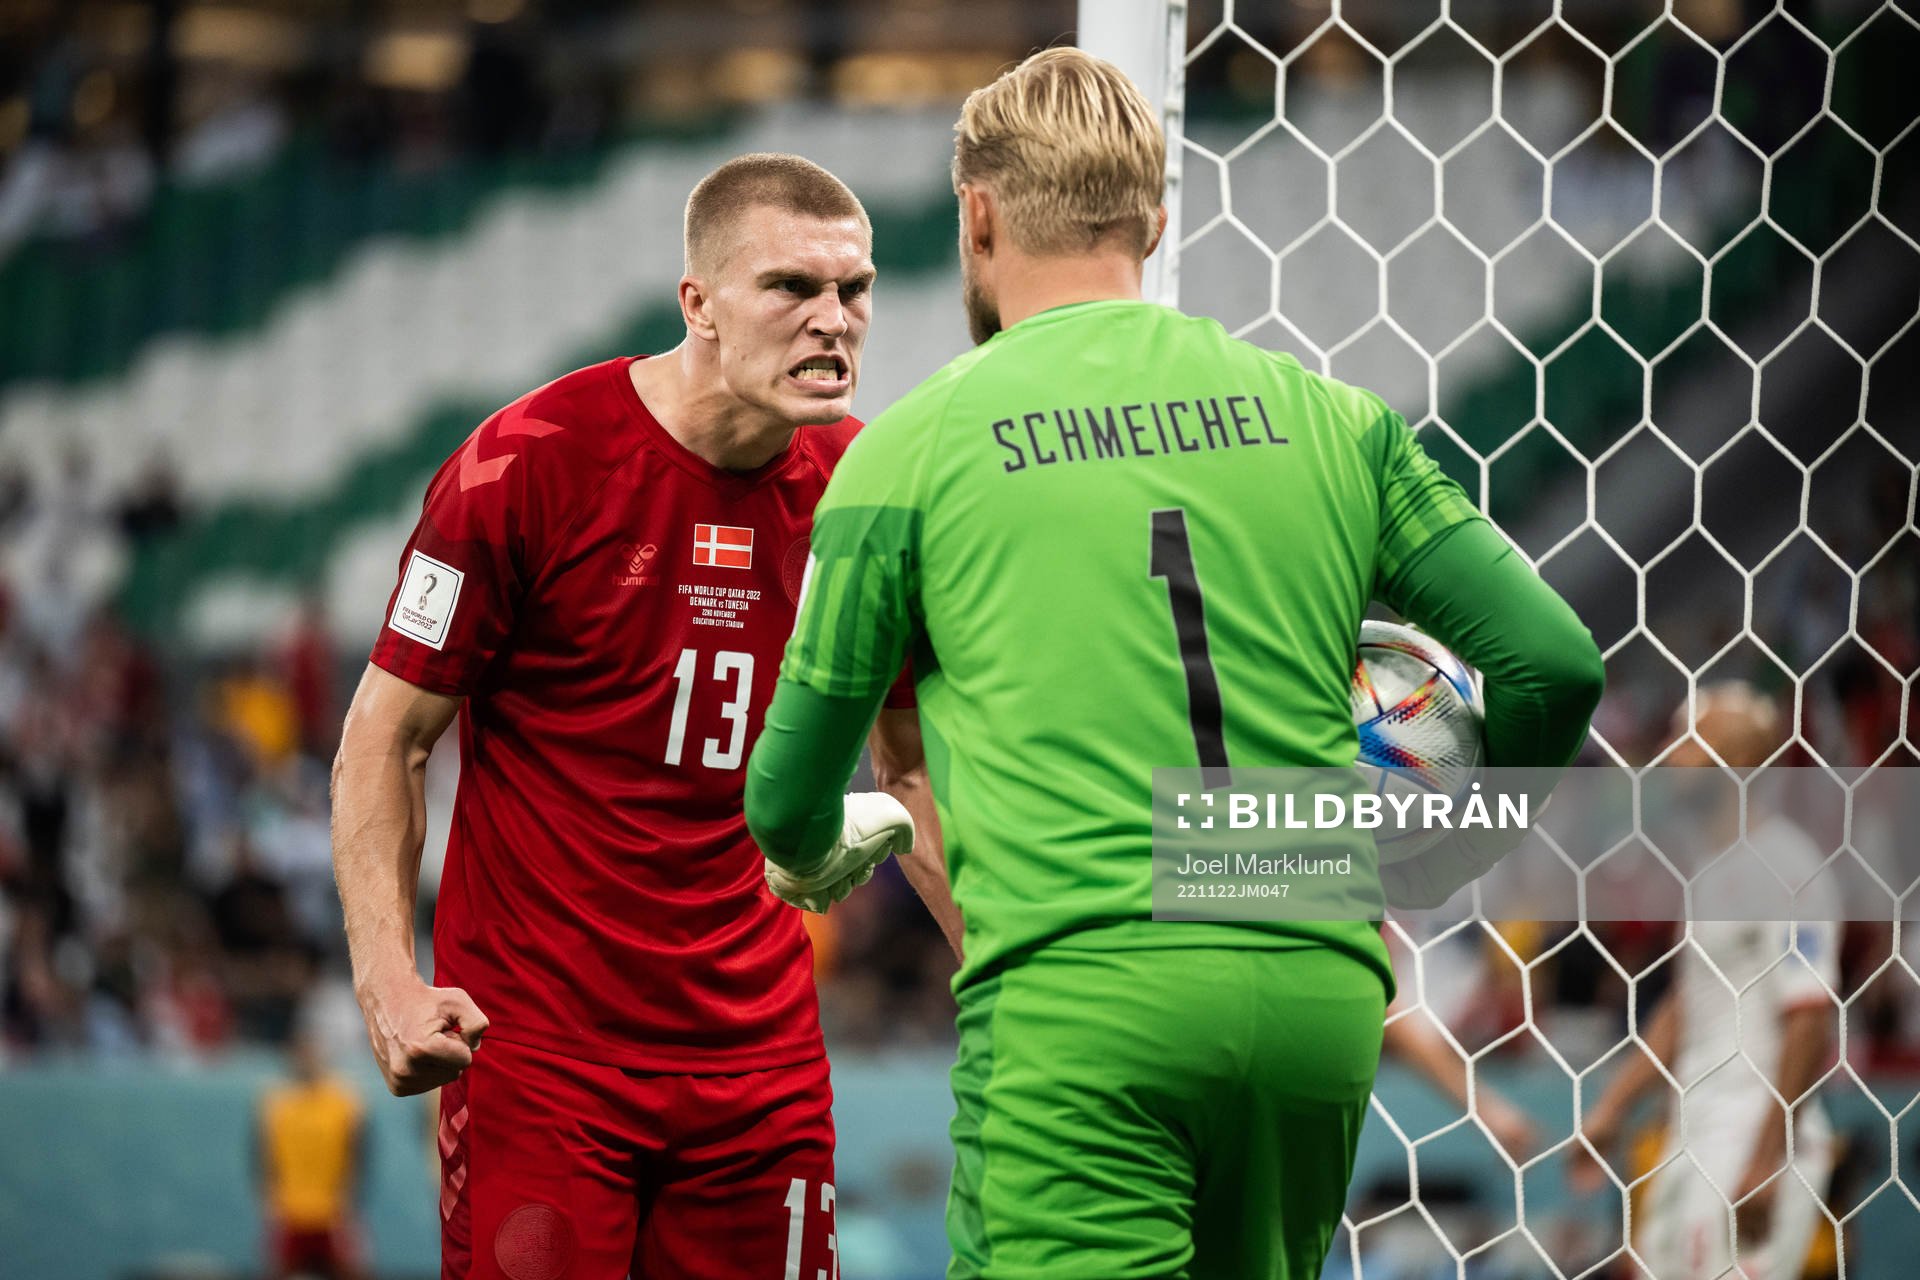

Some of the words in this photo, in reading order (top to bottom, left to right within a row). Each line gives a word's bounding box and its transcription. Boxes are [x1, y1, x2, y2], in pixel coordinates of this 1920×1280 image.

[992, 396, 1288, 473] SCHMEICHEL
[678, 584, 692, 594] FIFA
[694, 585, 714, 596] WORLD
[715, 587, 727, 597] CUP
[728, 588, 745, 599] QATAR
[746, 590, 761, 600] 2022
[690, 597, 717, 607] DENMARK
[410, 610, 426, 621] WORLD
[713, 610, 736, 619] NOVEMBER
[692, 616, 715, 626] EDUCATION
[715, 619, 725, 627] CITY
[725, 620, 745, 629] STADIUM
[1149, 508, 1232, 790] 1
[664, 648, 755, 770] 13
